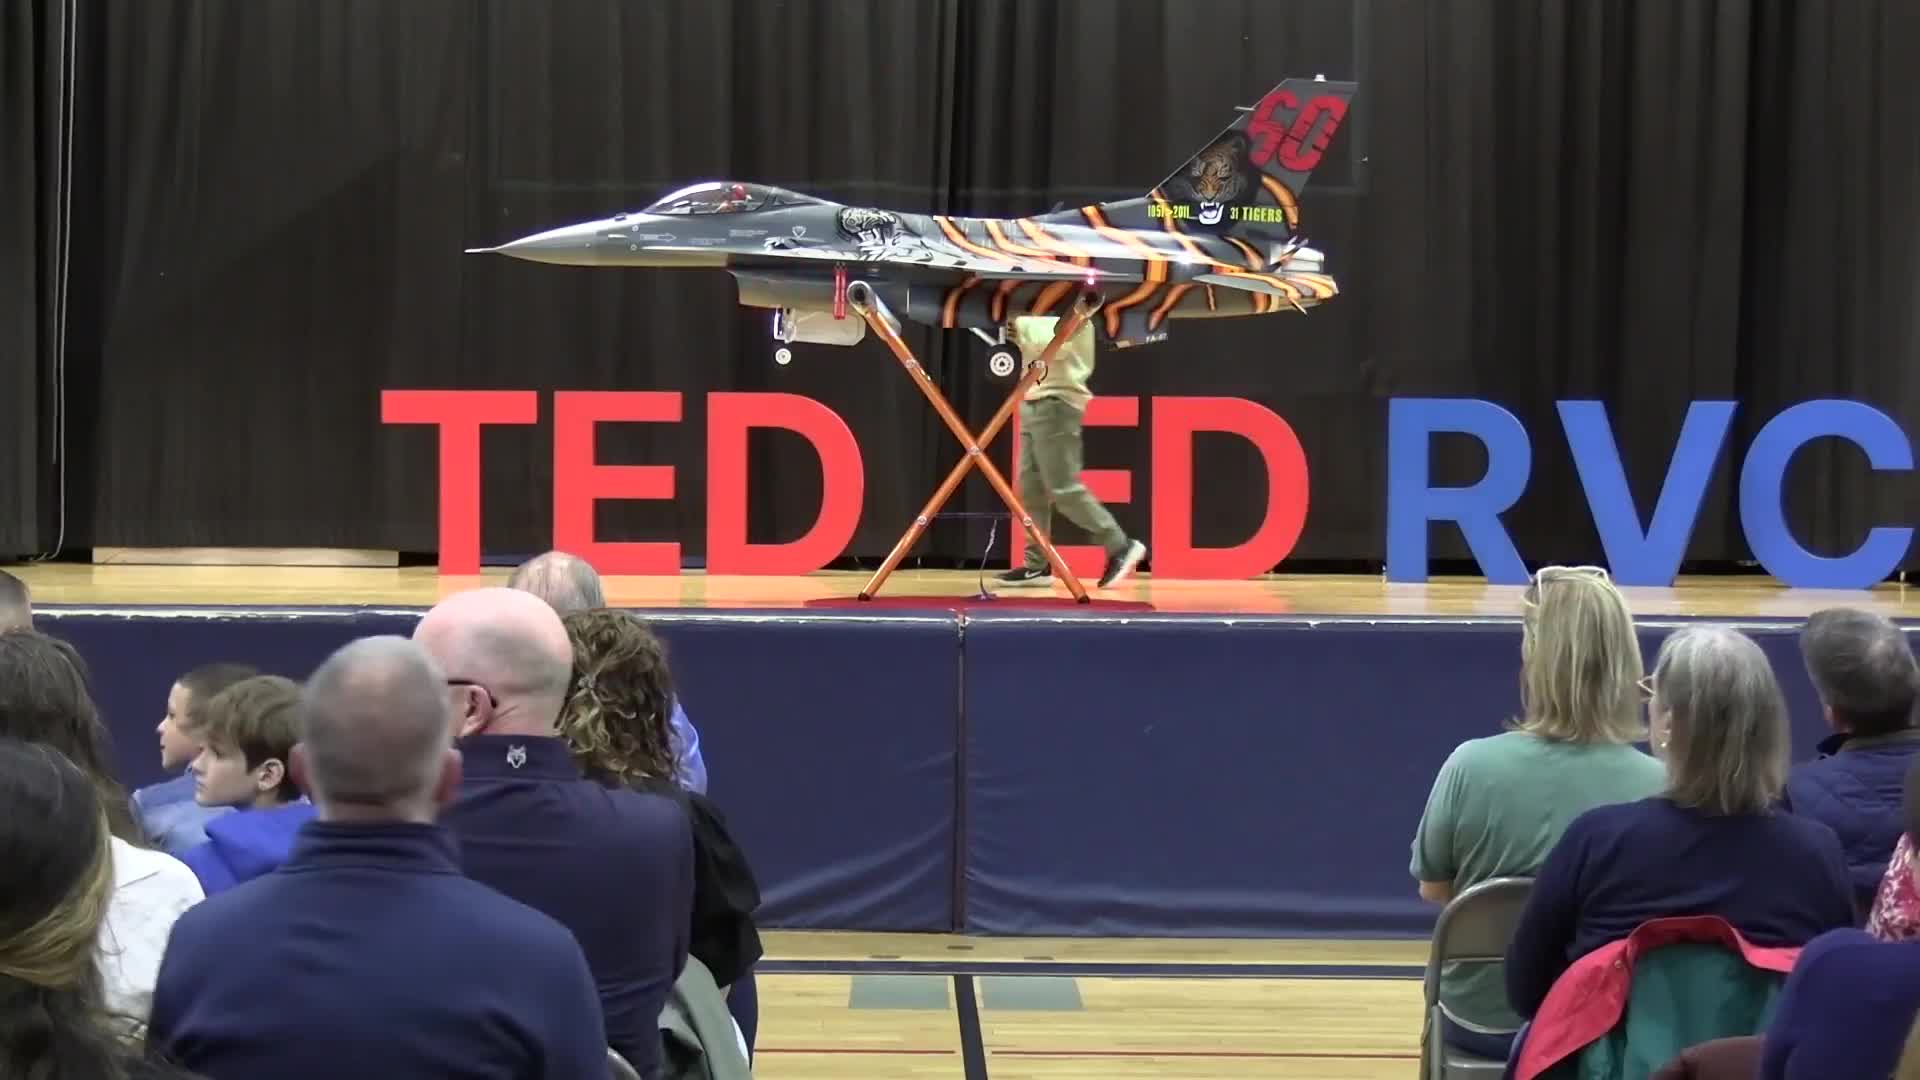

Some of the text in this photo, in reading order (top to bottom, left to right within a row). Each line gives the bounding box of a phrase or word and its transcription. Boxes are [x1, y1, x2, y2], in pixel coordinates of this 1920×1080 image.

[1230, 207, 1239, 220] 31
[1242, 207, 1282, 222] TIGERS
[381, 390, 864, 576] TED
[1386, 398, 1915, 590] RVC
